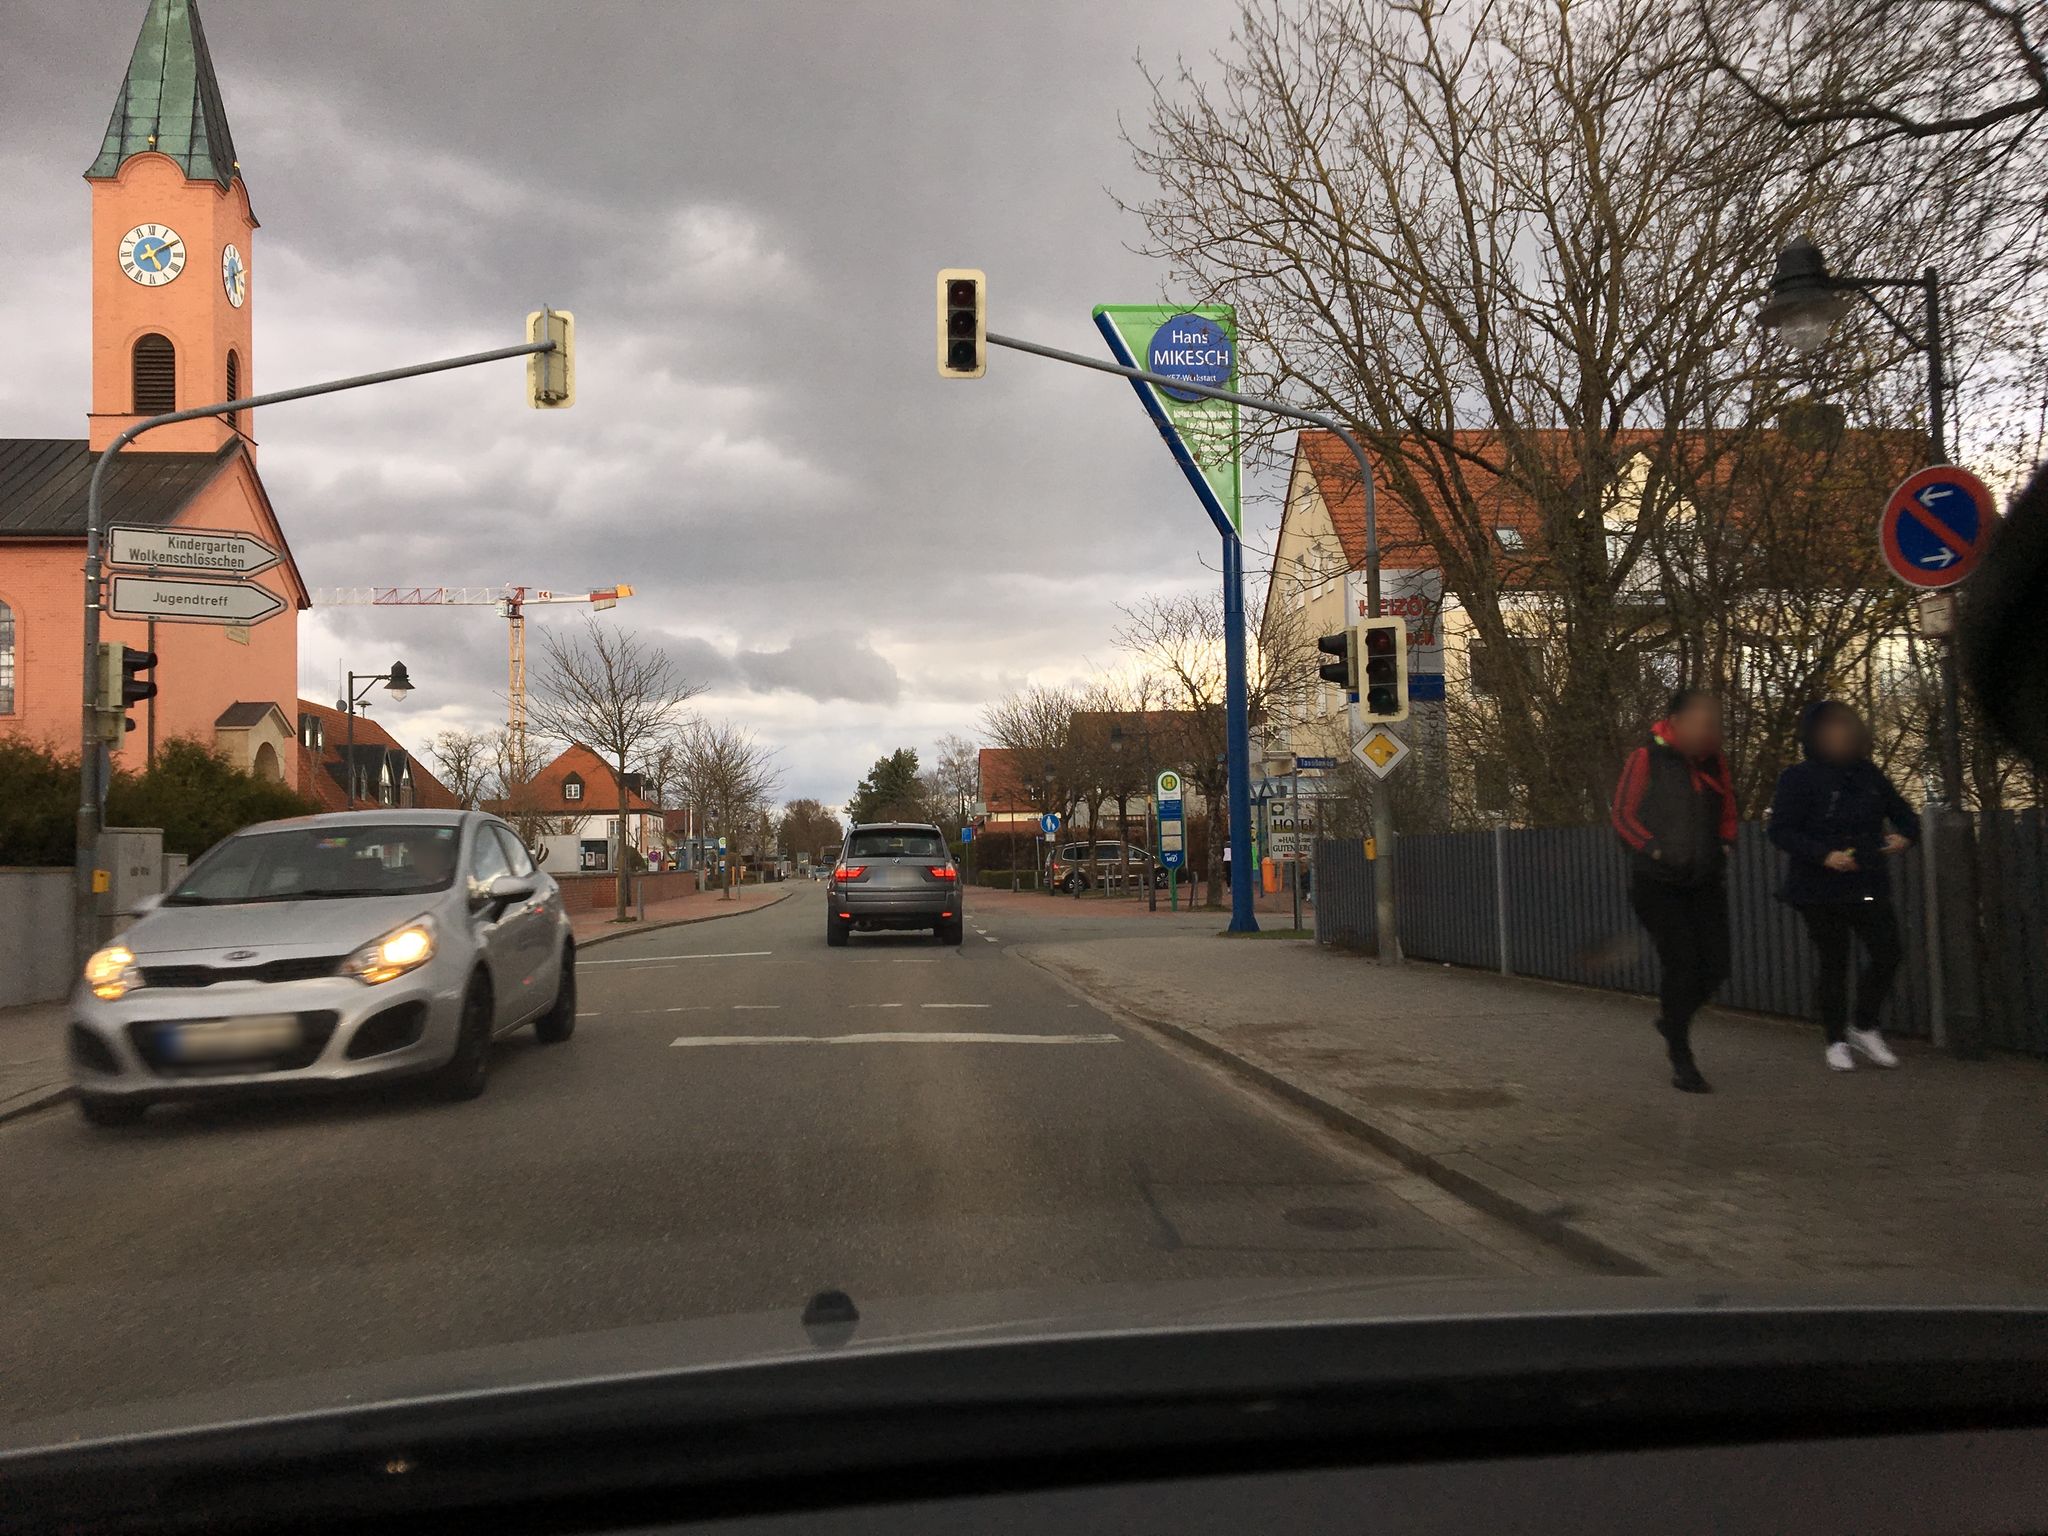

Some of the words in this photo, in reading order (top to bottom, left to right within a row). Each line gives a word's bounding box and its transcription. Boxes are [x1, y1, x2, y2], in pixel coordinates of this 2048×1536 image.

[1172, 330, 1209, 344] Hans
[1154, 350, 1229, 365] MIKESCH
[168, 536, 245, 554] Kindergarten
[129, 548, 245, 568] Wolkenschlösschen
[153, 593, 228, 606] Jugendtreff
[1165, 779, 1173, 787] H
